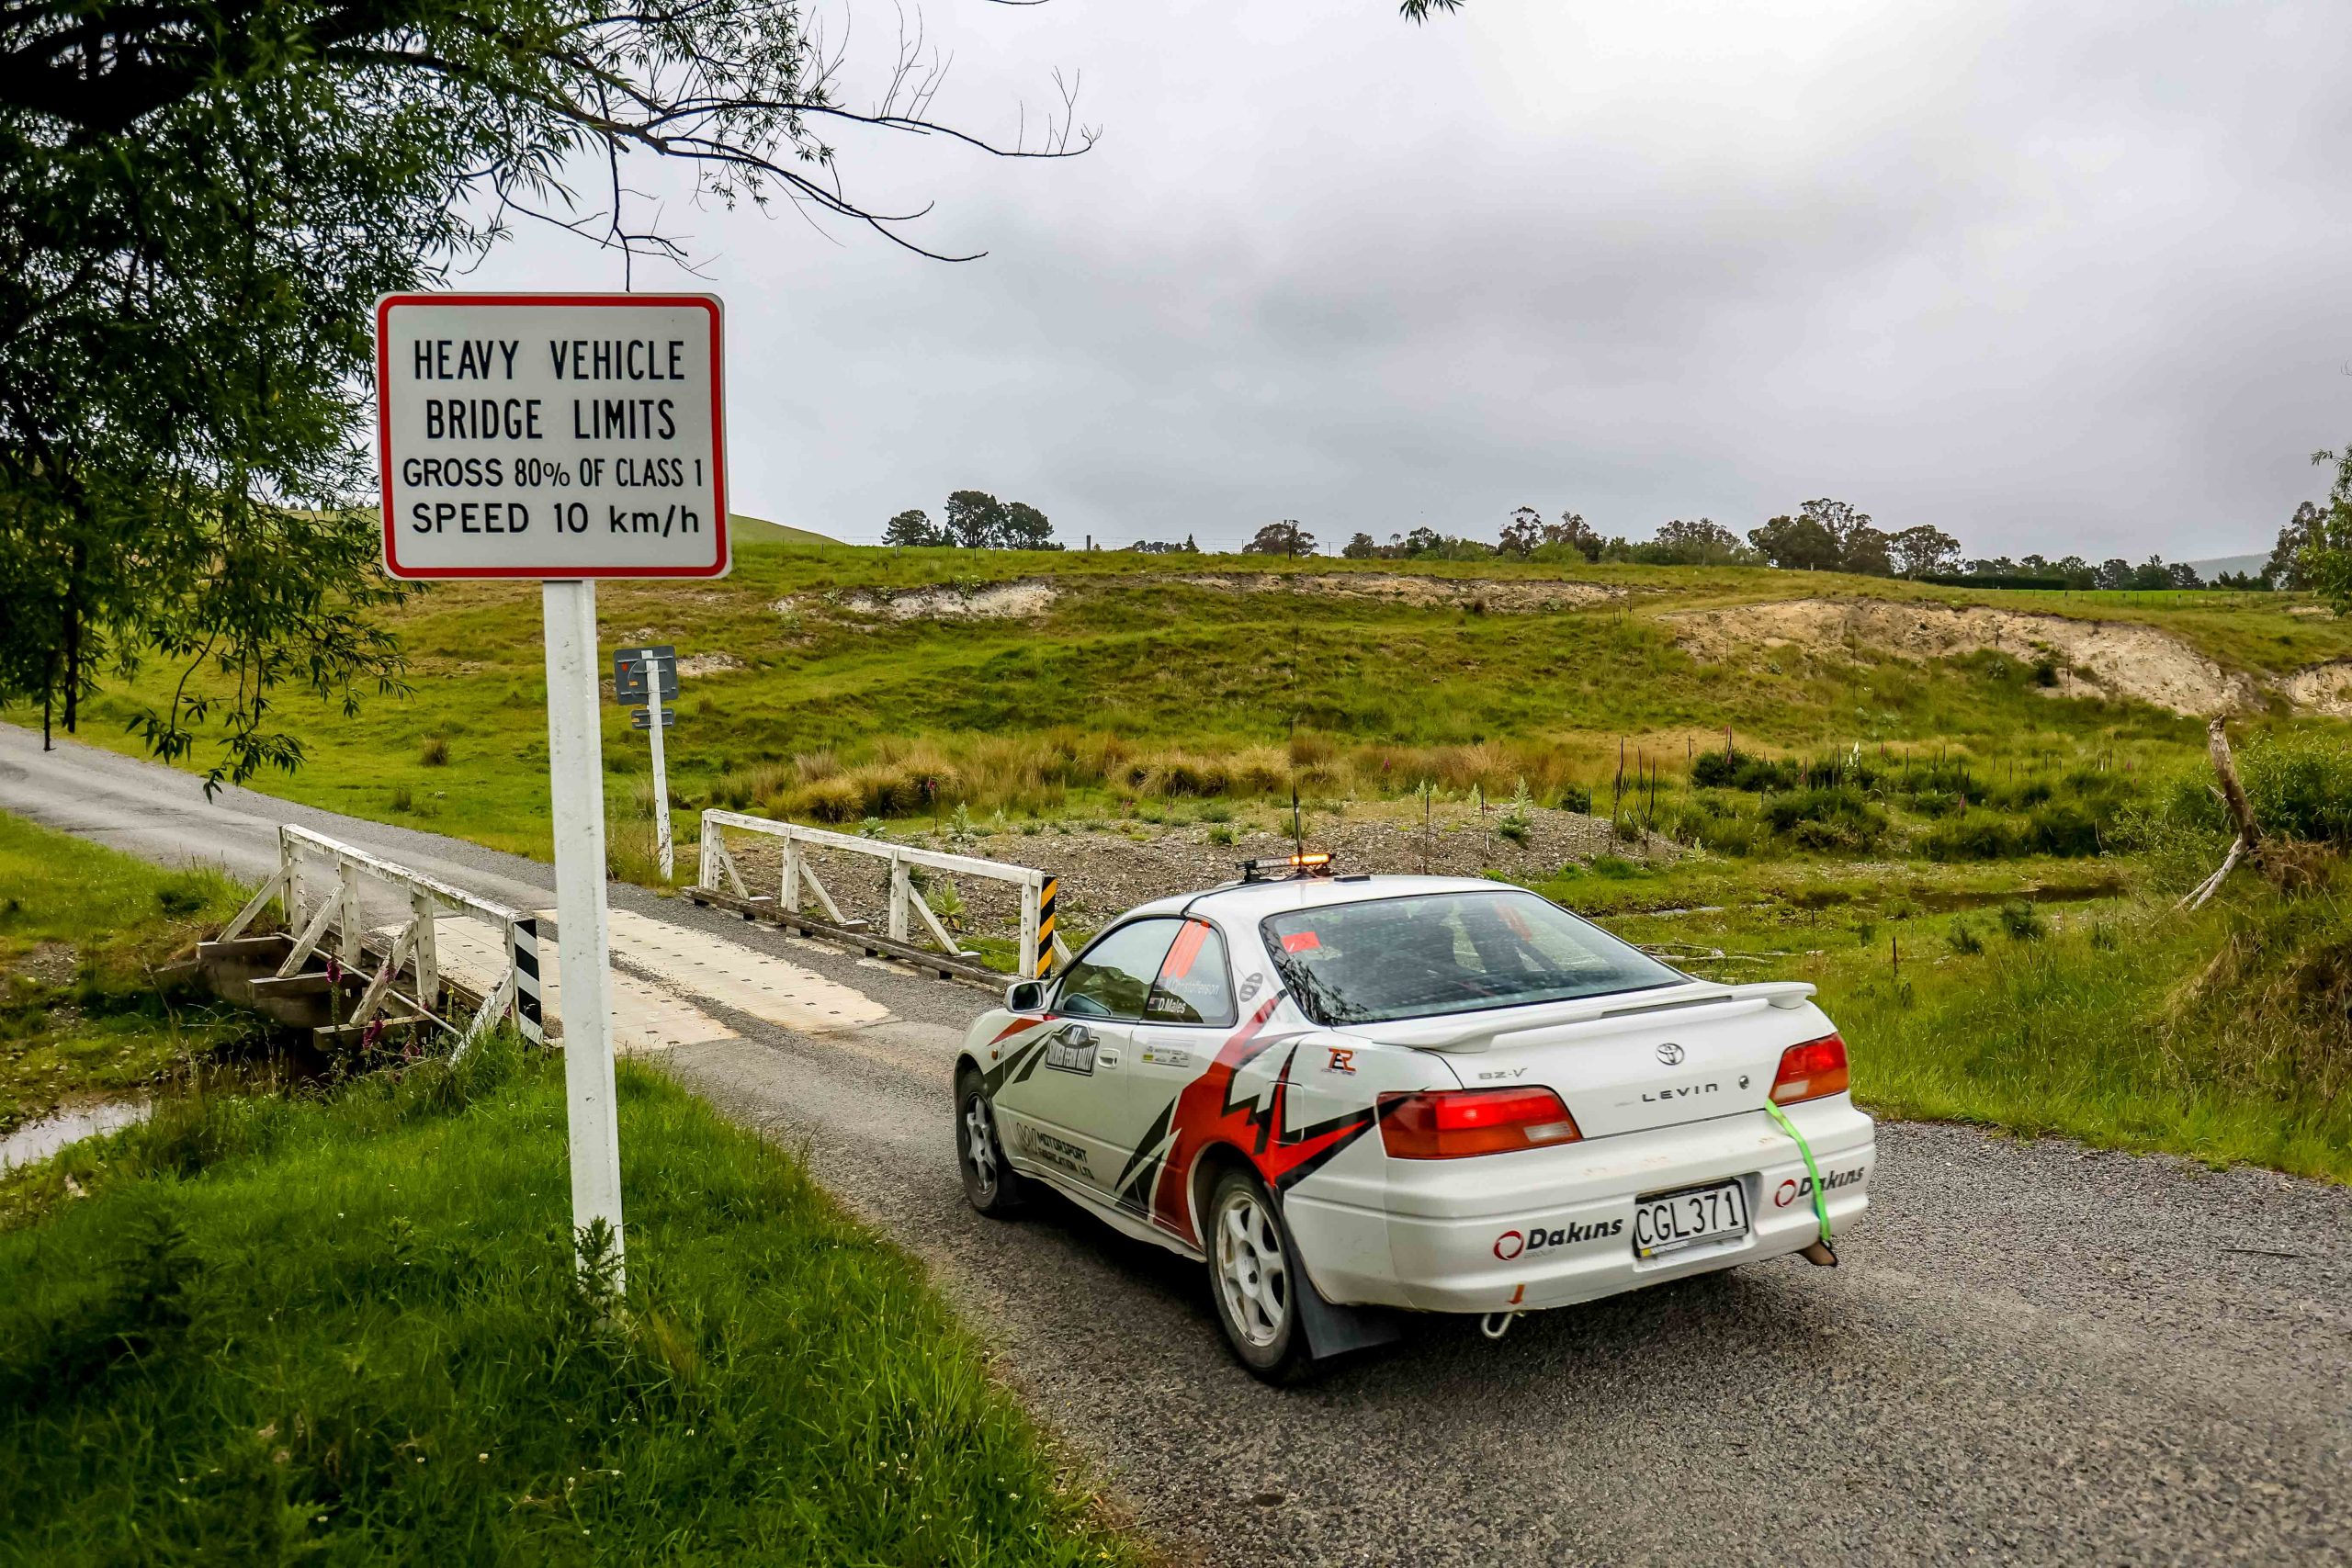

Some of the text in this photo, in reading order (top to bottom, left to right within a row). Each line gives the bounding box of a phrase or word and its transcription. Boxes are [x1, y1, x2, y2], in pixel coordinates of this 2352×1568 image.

[414, 340, 685, 380] HEAVY VEHICLE
[425, 399, 676, 440] BRIDGE LIMITS
[402, 457, 702, 488] GROSS 80% OF CLASS 1
[412, 502, 699, 538] SPEED 10 km/h
[1642, 1083, 1718, 1102] LEVIN
[1525, 1218, 1624, 1250] Dakins
[1636, 1190, 1739, 1245] CGL371
